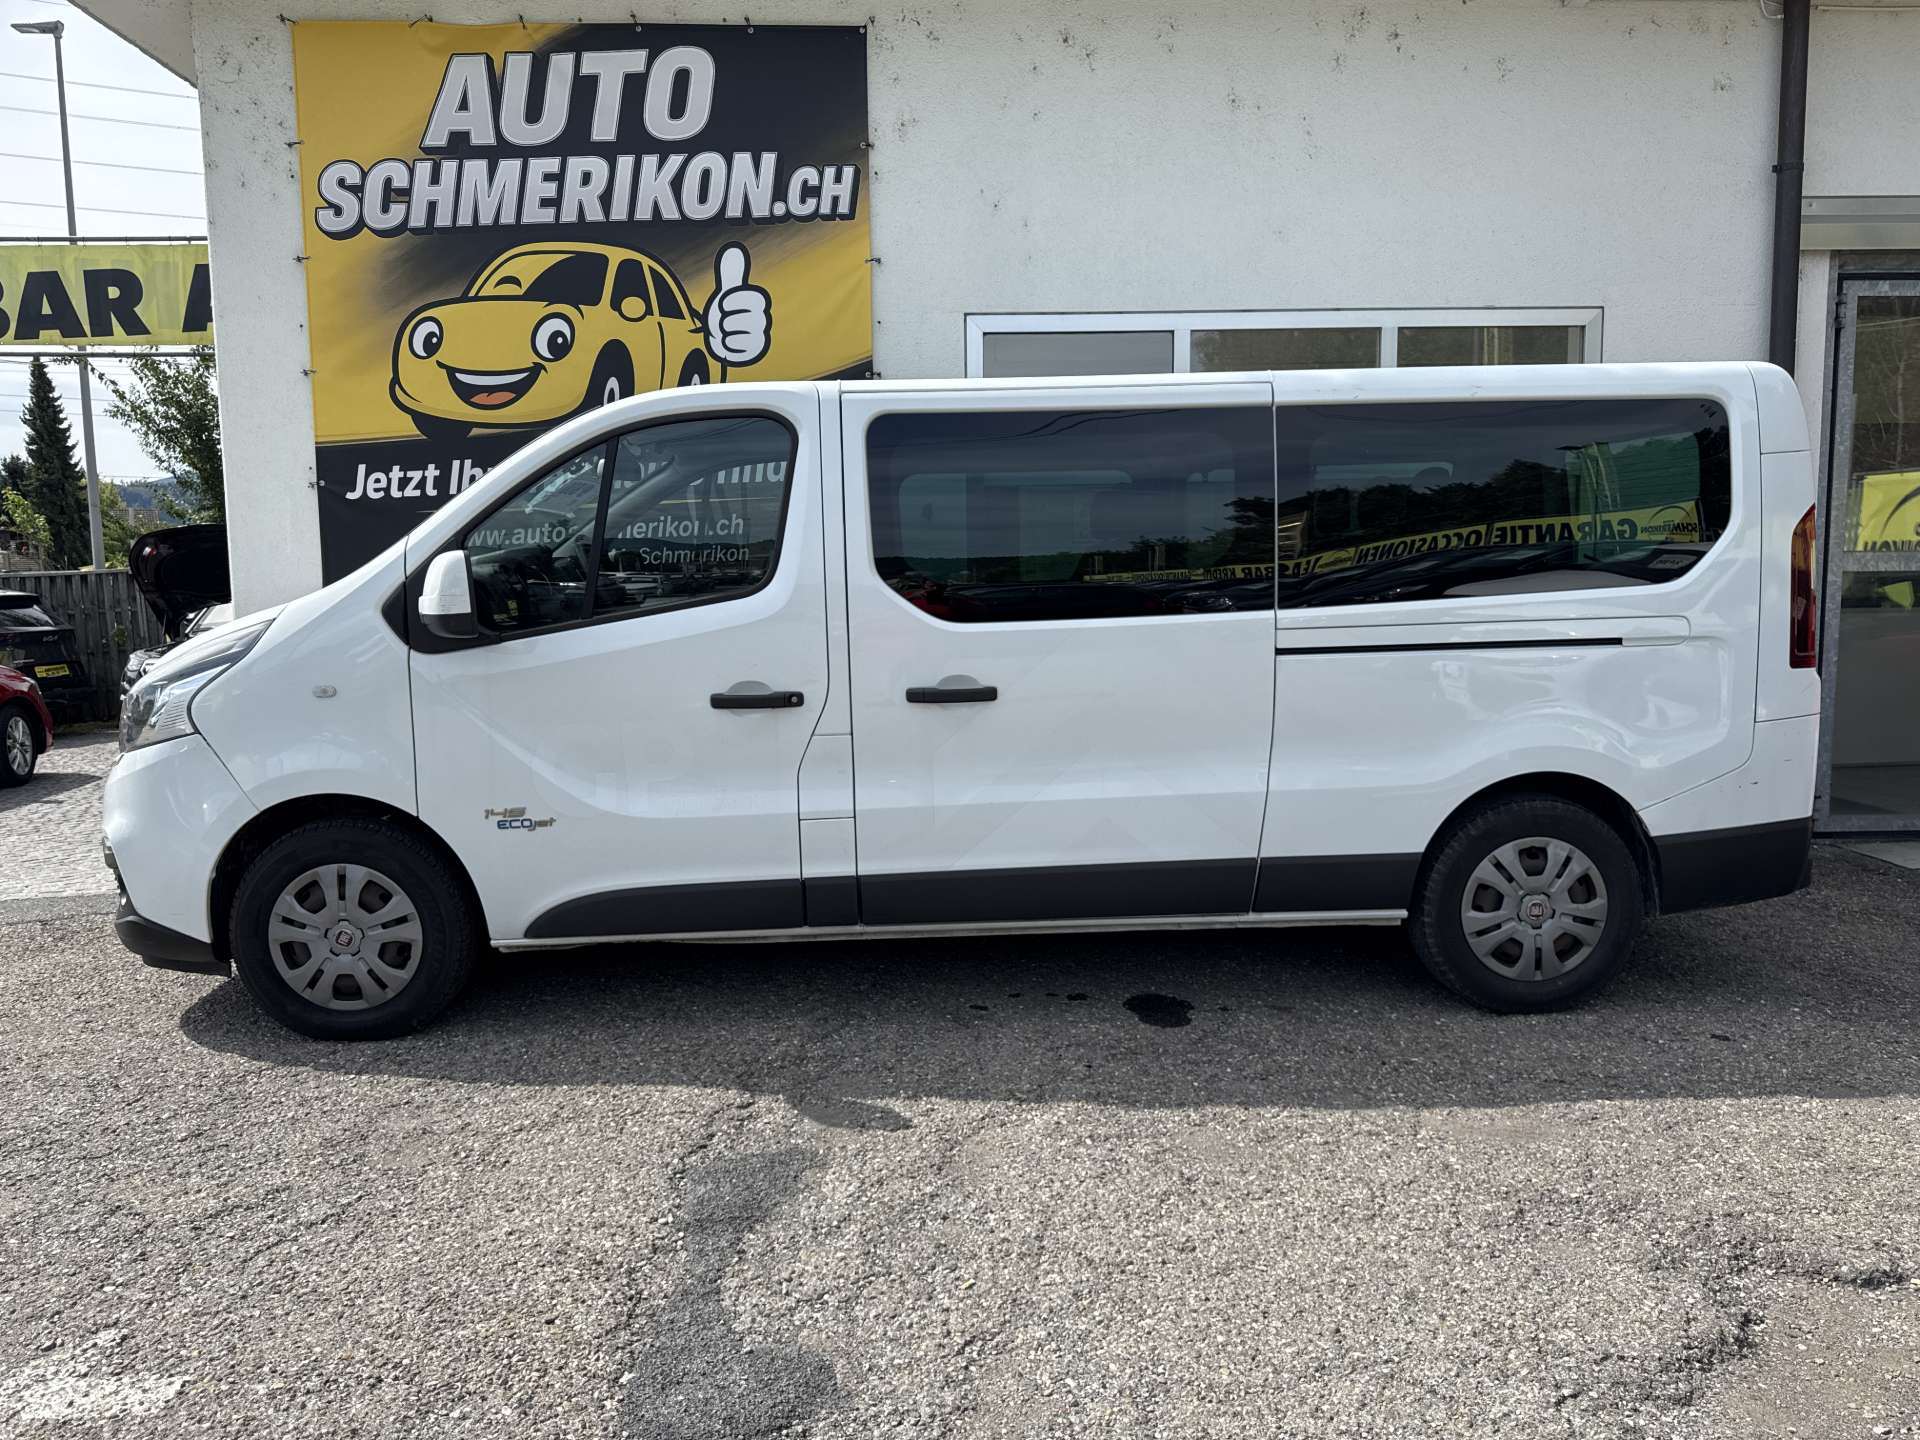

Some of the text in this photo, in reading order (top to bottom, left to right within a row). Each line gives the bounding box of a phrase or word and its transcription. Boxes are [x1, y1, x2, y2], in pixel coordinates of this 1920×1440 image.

[421, 45, 715, 150] AUTO
[317, 151, 857, 235] SCHMERIKON.CH
[0, 268, 151, 340] AR
[345, 458, 497, 500] Jetzt Ih
